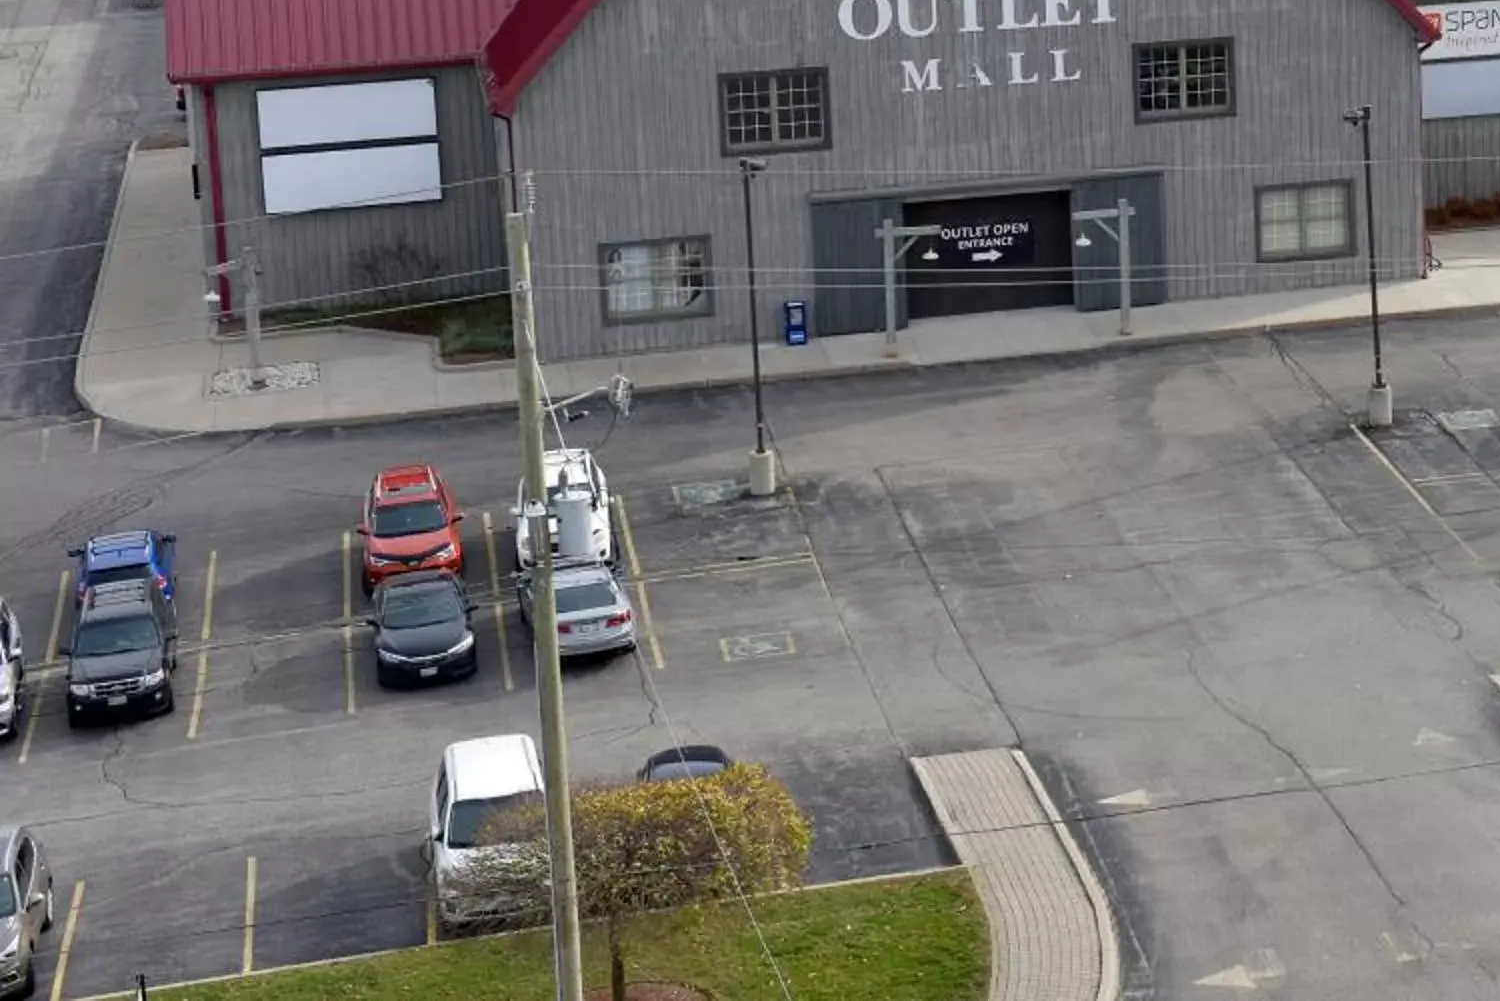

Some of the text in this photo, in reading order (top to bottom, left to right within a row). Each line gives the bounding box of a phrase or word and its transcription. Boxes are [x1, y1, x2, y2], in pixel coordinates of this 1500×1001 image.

[941, 222, 1029, 240] OUTLET OPEN
[957, 236, 1013, 249] ENTRANCE
